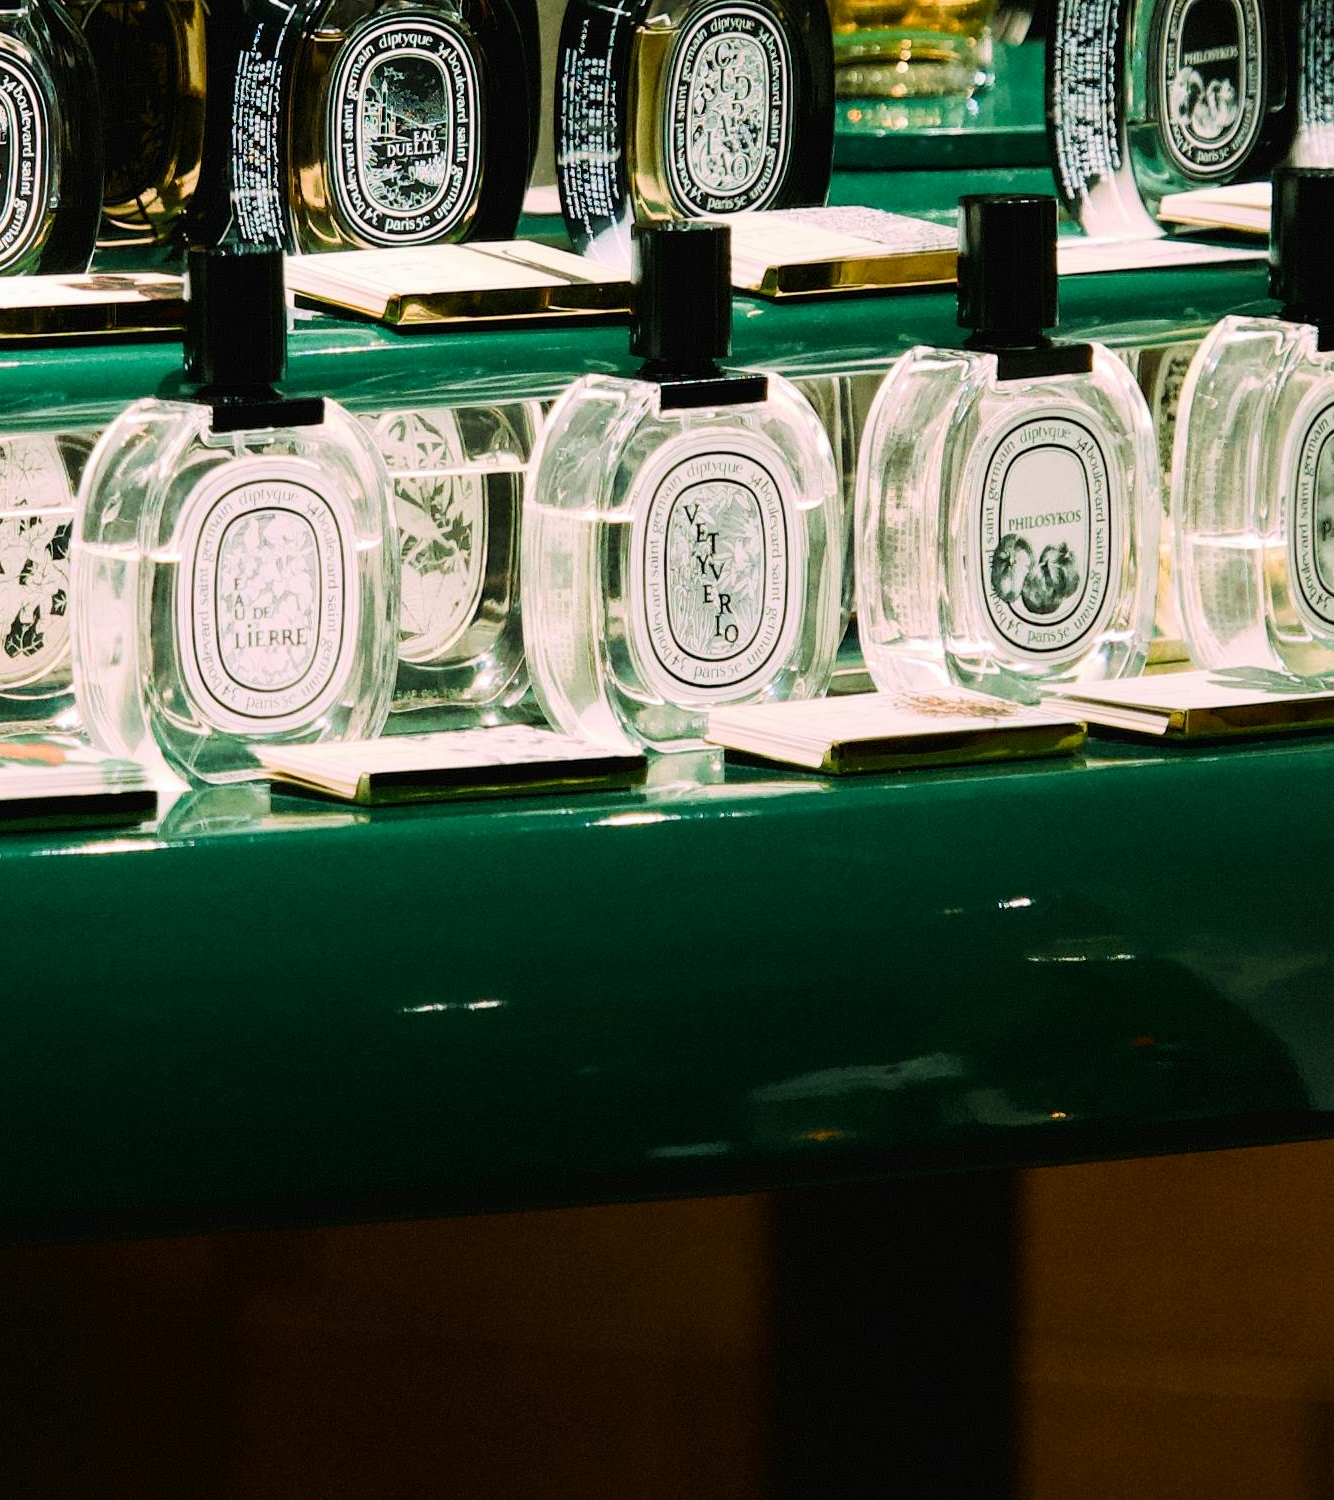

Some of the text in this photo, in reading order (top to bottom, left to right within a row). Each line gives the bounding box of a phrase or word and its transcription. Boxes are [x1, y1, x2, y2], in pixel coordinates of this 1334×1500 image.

[379, 33, 433, 50] diptyque
[710, 17, 755, 33] diptyque
[346, 45, 374, 100] germain
[676, 86, 688, 120] saint
[682, 28, 707, 83] germain
[343, 104, 354, 140] saint
[413, 130, 437, 142] EAU
[771, 109, 781, 143] saint
[386, 141, 440, 157] DUELLE
[457, 127, 467, 161] saint
[22, 161, 34, 196] saint
[433, 164, 463, 218] germain
[750, 147, 776, 200] germain
[1019, 426, 1071, 445] diptyque
[1304, 418, 1329, 477] germain
[687, 461, 743, 478] diptyque
[239, 490, 299, 506] diptyque
[652, 473, 683, 534] germain
[986, 441, 1016, 544] saint germain
[1299, 483, 1310, 520] saint
[202, 502, 234, 563] germain
[1008, 510, 1082, 531] PHILOSYKOS
[649, 540, 660, 576] saint
[1095, 527, 1105, 566] saint
[200, 567, 210, 607] saint
[772, 562, 781, 601] saint
[1074, 569, 1102, 631] germain
[253, 607, 271, 620] DE
[327, 594, 338, 634] saint
[747, 605, 778, 665] germain
[301, 638, 334, 695] germain
